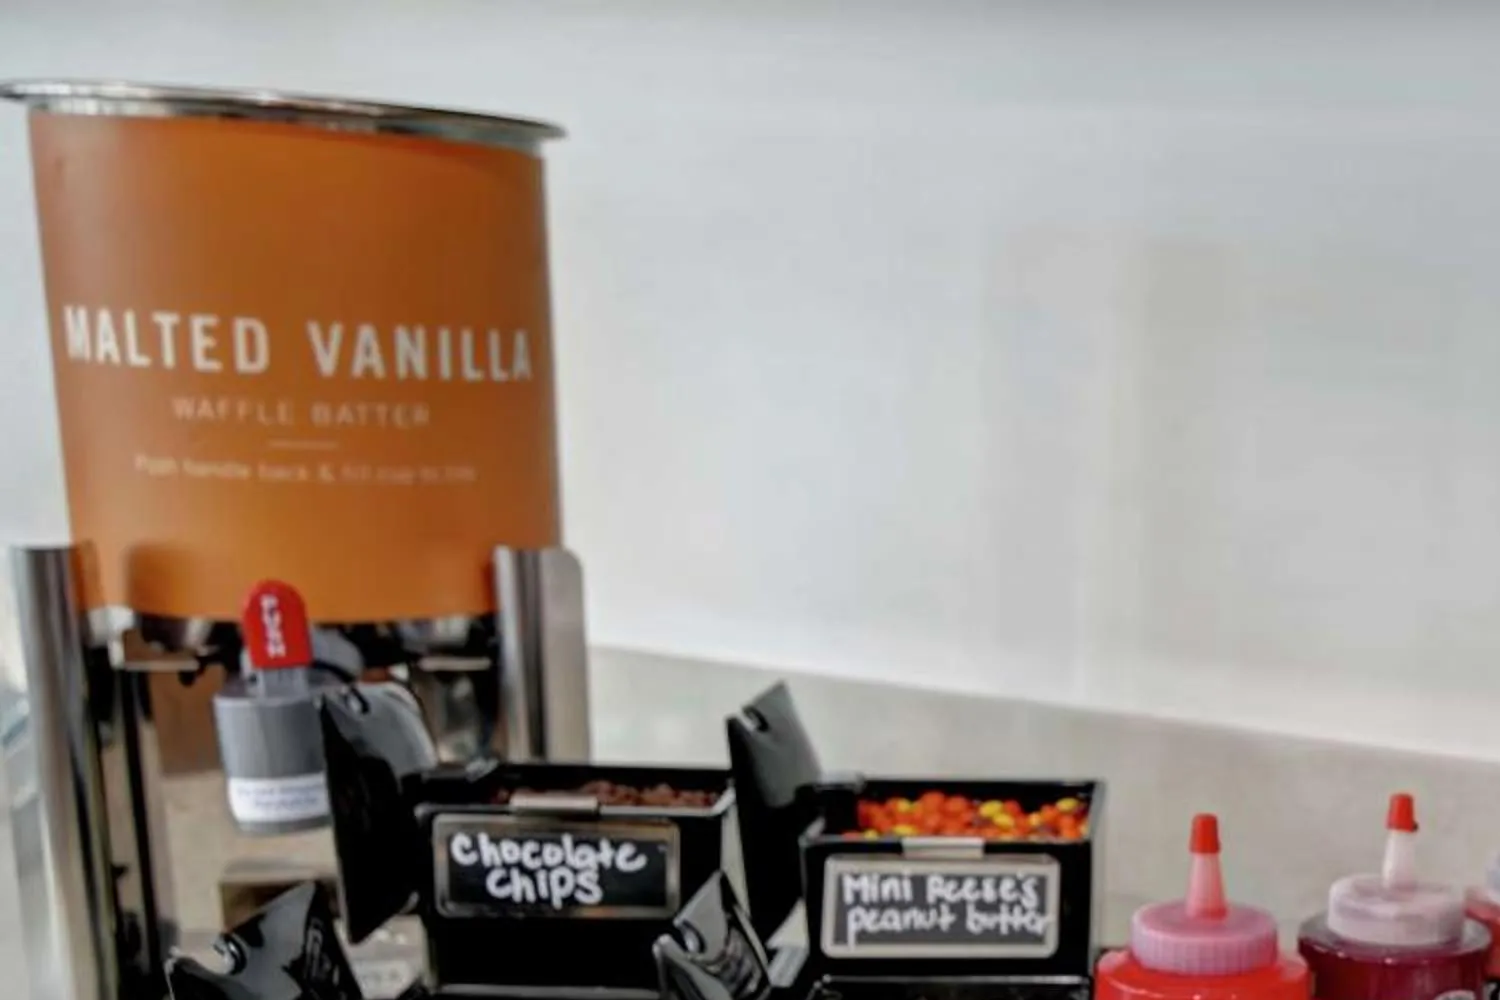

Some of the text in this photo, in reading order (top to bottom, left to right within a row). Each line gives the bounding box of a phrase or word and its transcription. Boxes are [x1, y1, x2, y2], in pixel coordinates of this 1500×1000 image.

[65, 305, 532, 381] MALTED VANILLA
[172, 397, 430, 428] WAFFLE BATTER
[451, 832, 648, 873] Chocolate
[842, 872, 913, 904] Mini
[847, 904, 956, 951] peanut
